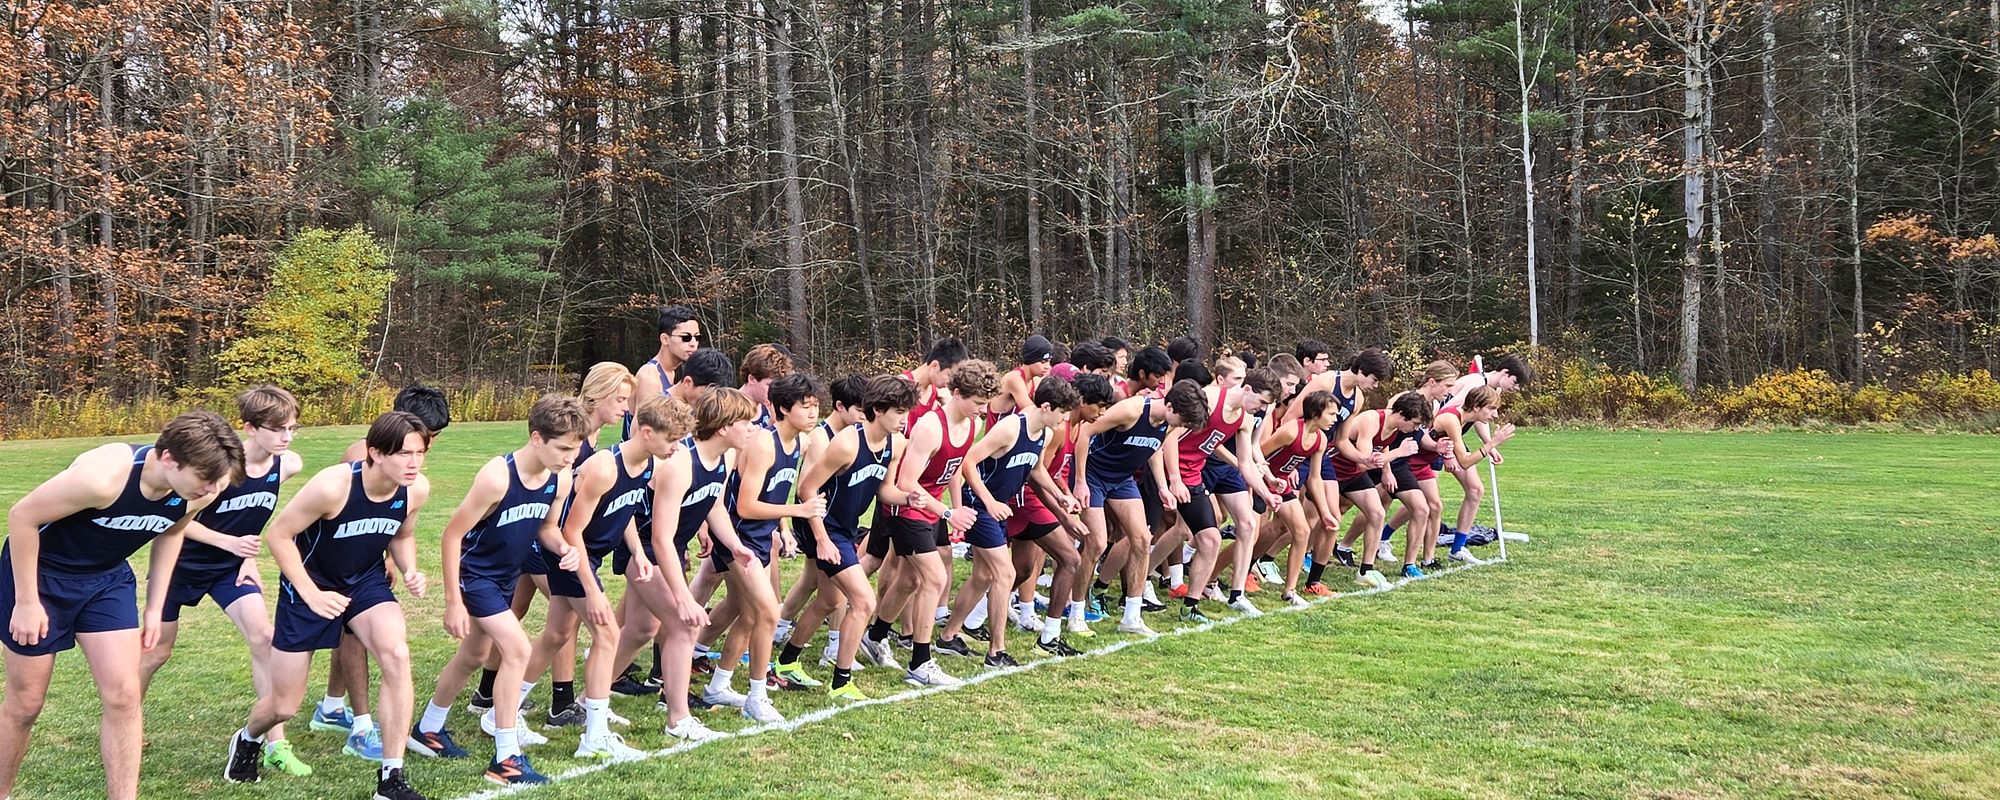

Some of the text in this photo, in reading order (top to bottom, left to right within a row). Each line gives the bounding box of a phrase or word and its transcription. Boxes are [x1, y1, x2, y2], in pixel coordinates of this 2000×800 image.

[1199, 429, 1226, 455] E
[936, 456, 963, 485] E
[1280, 455, 1306, 473] E
[216, 491, 277, 513] ANDOVE
[91, 515, 176, 533] ANDOVE
[333, 517, 401, 539] ANDOVE
